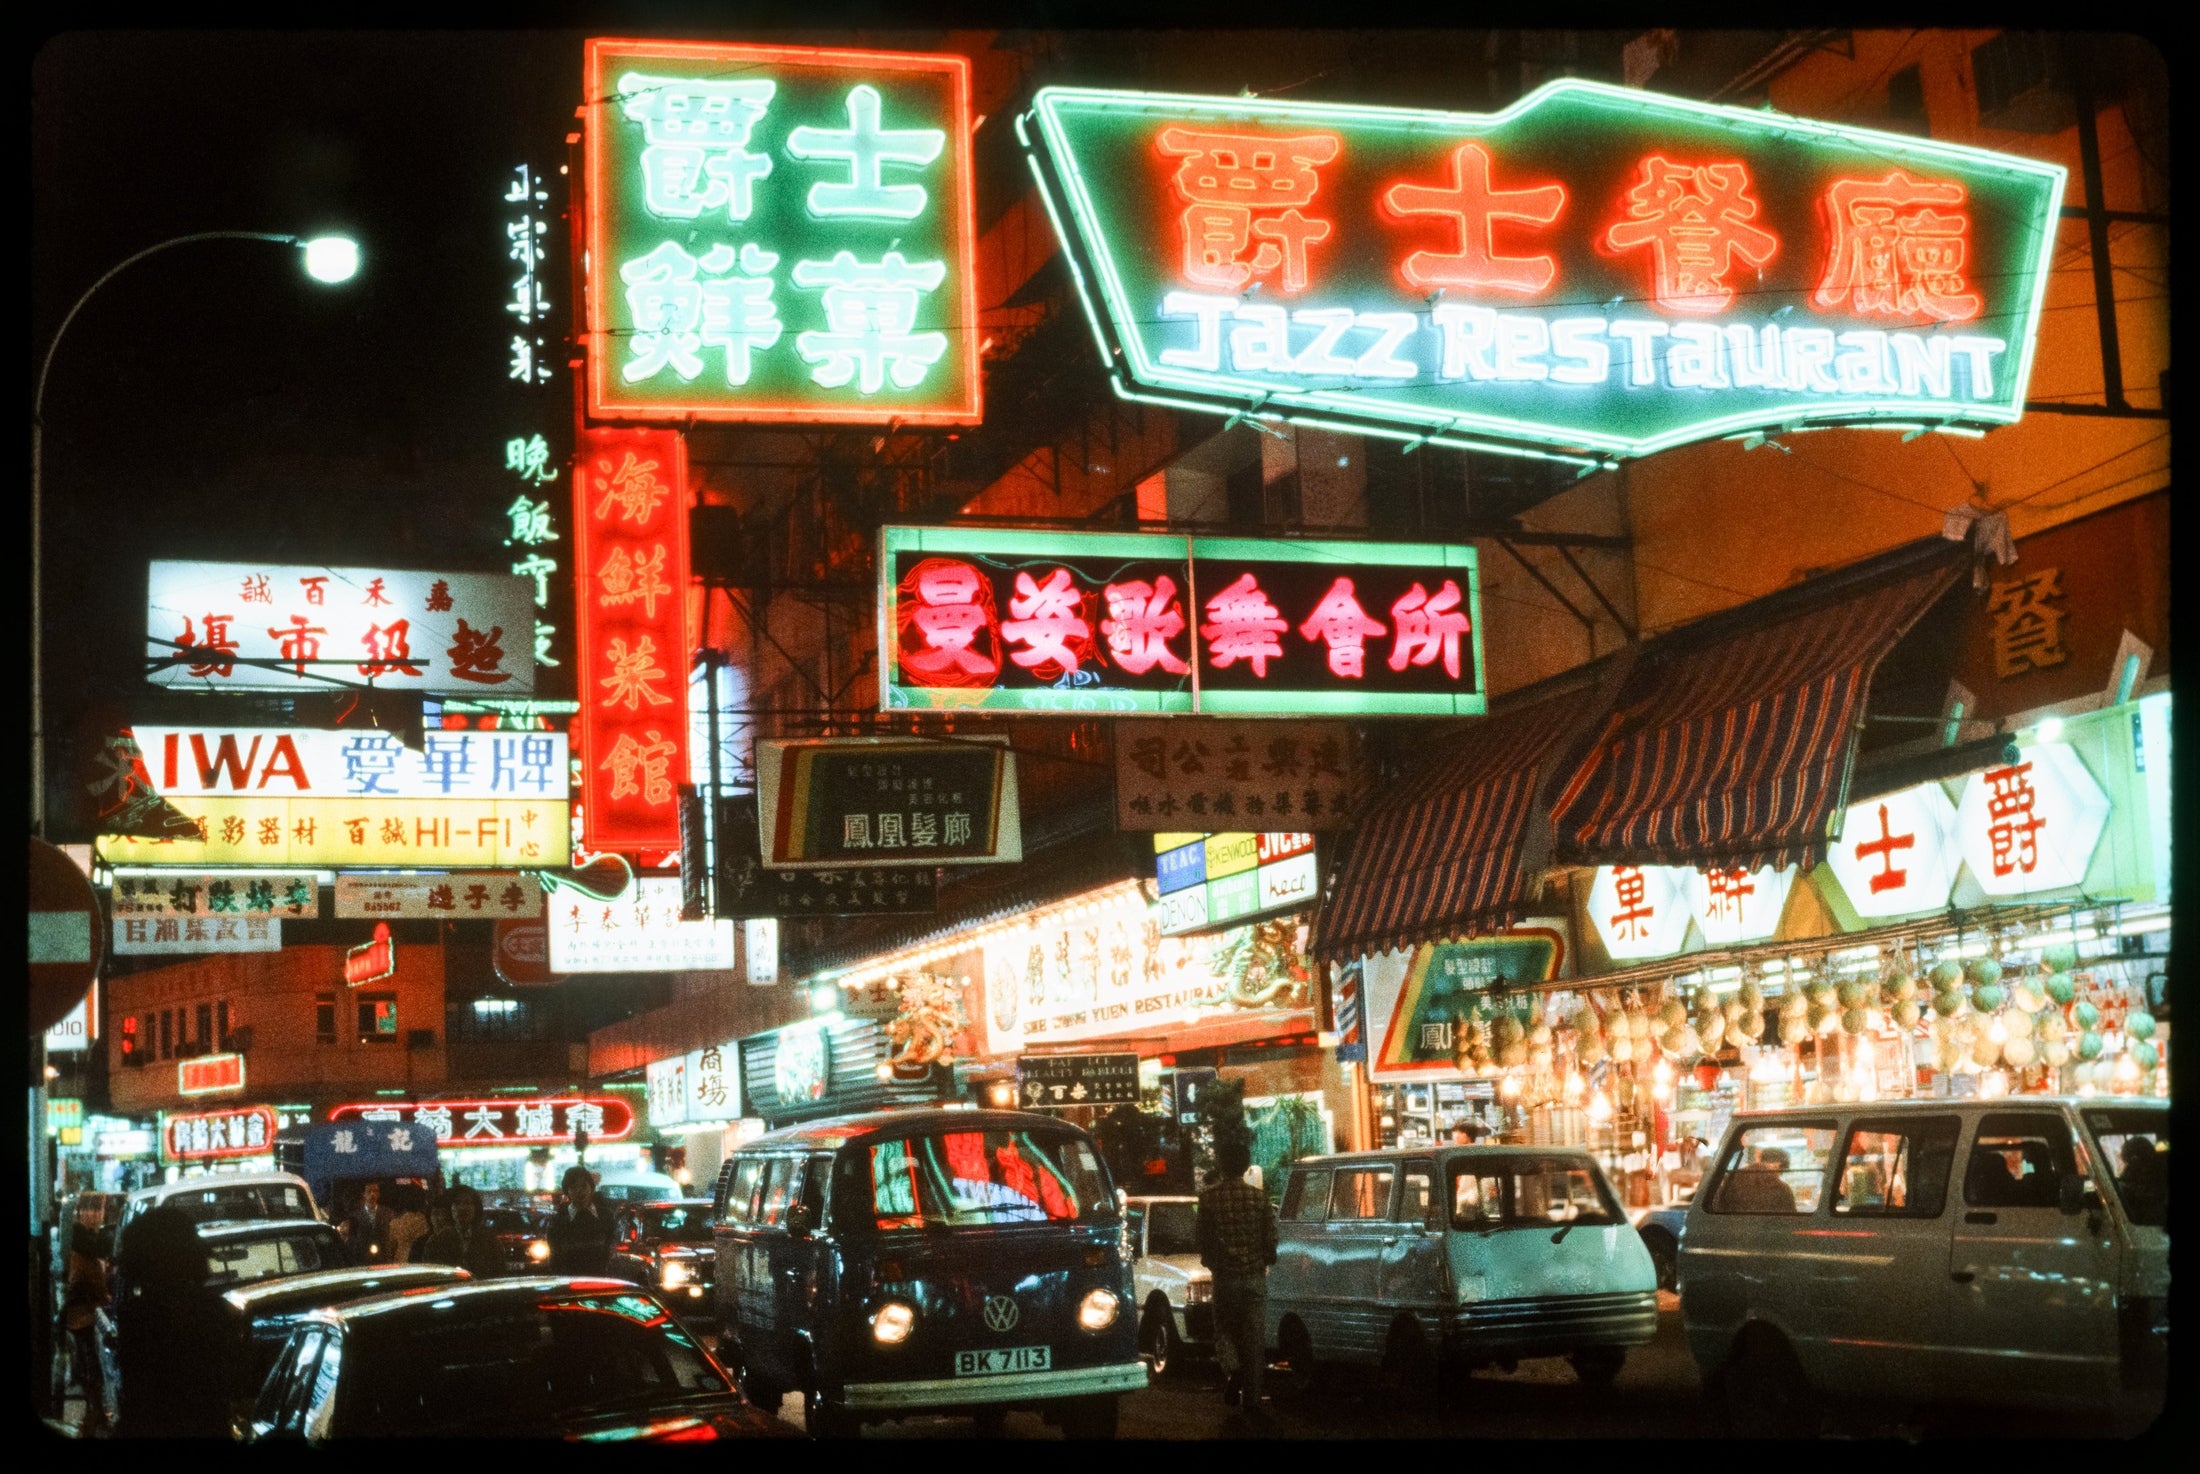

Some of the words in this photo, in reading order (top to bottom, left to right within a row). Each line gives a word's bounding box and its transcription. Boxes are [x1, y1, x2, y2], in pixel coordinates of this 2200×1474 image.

[617, 72, 946, 222] 爵士
[1154, 126, 1980, 320] 爵士餐廳
[619, 241, 948, 394] 鮮菓
[1158, 290, 1419, 379] Jazz
[594, 451, 678, 806] 海鮮菜館
[1987, 566, 2070, 682] 餐
[341, 732, 554, 795] 愛華牌
[842, 811, 972, 850] 鳳凰髮廊
[1214, 837, 1258, 865] KENWOOD
[1162, 893, 1206, 929] DENON
[1134, 981, 1232, 1015] RESTAURAN
[959, 1351, 992, 1373] BK
[998, 1347, 1046, 1370] 7113
